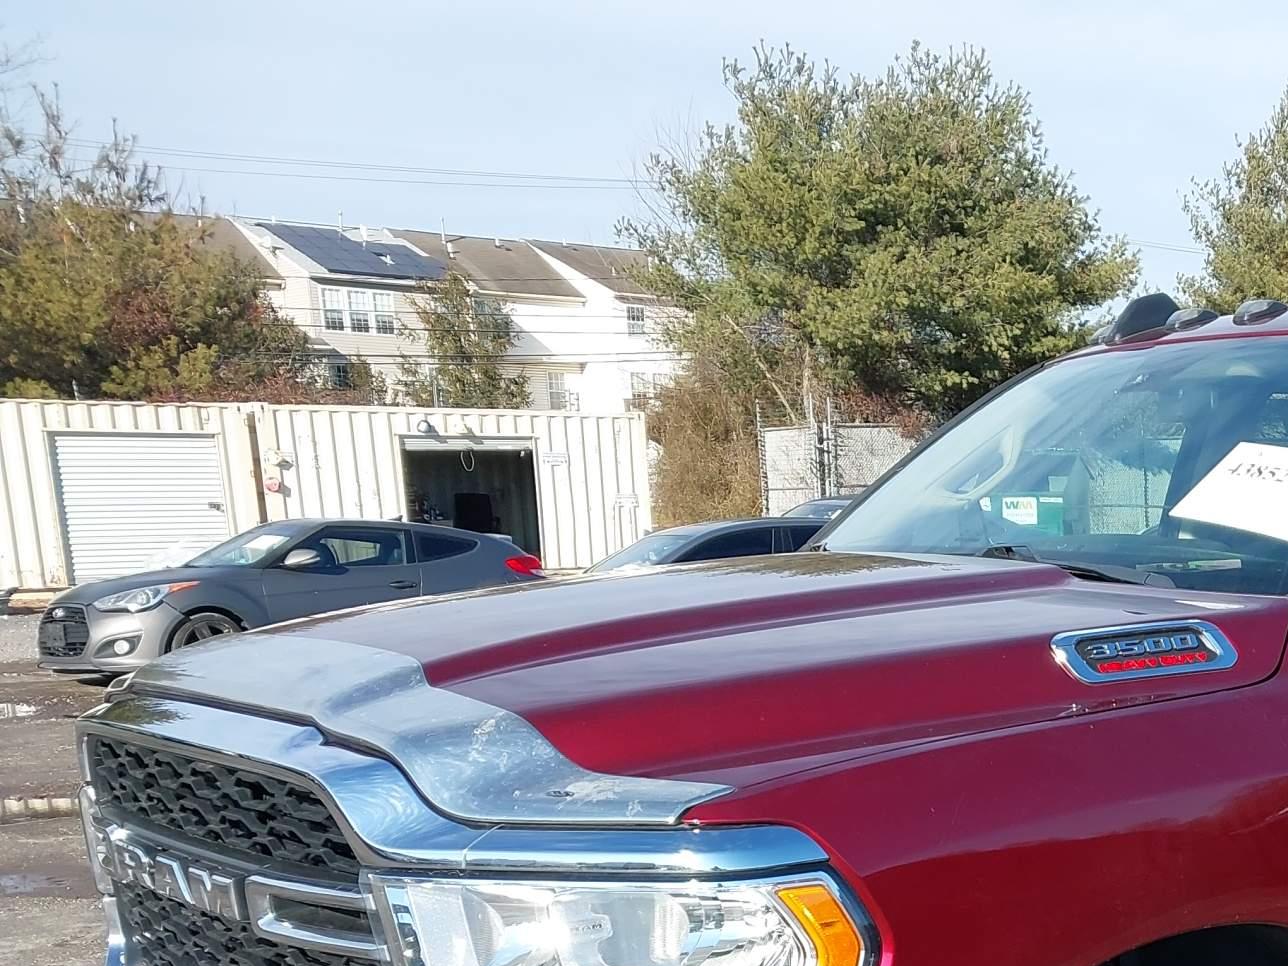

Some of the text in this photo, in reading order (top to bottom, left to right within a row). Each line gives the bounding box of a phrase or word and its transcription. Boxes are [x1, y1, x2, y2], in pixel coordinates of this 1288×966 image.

[1004, 500, 1034, 511] WM
[1086, 633, 1200, 660] 3500
[112, 838, 250, 922] RAM
